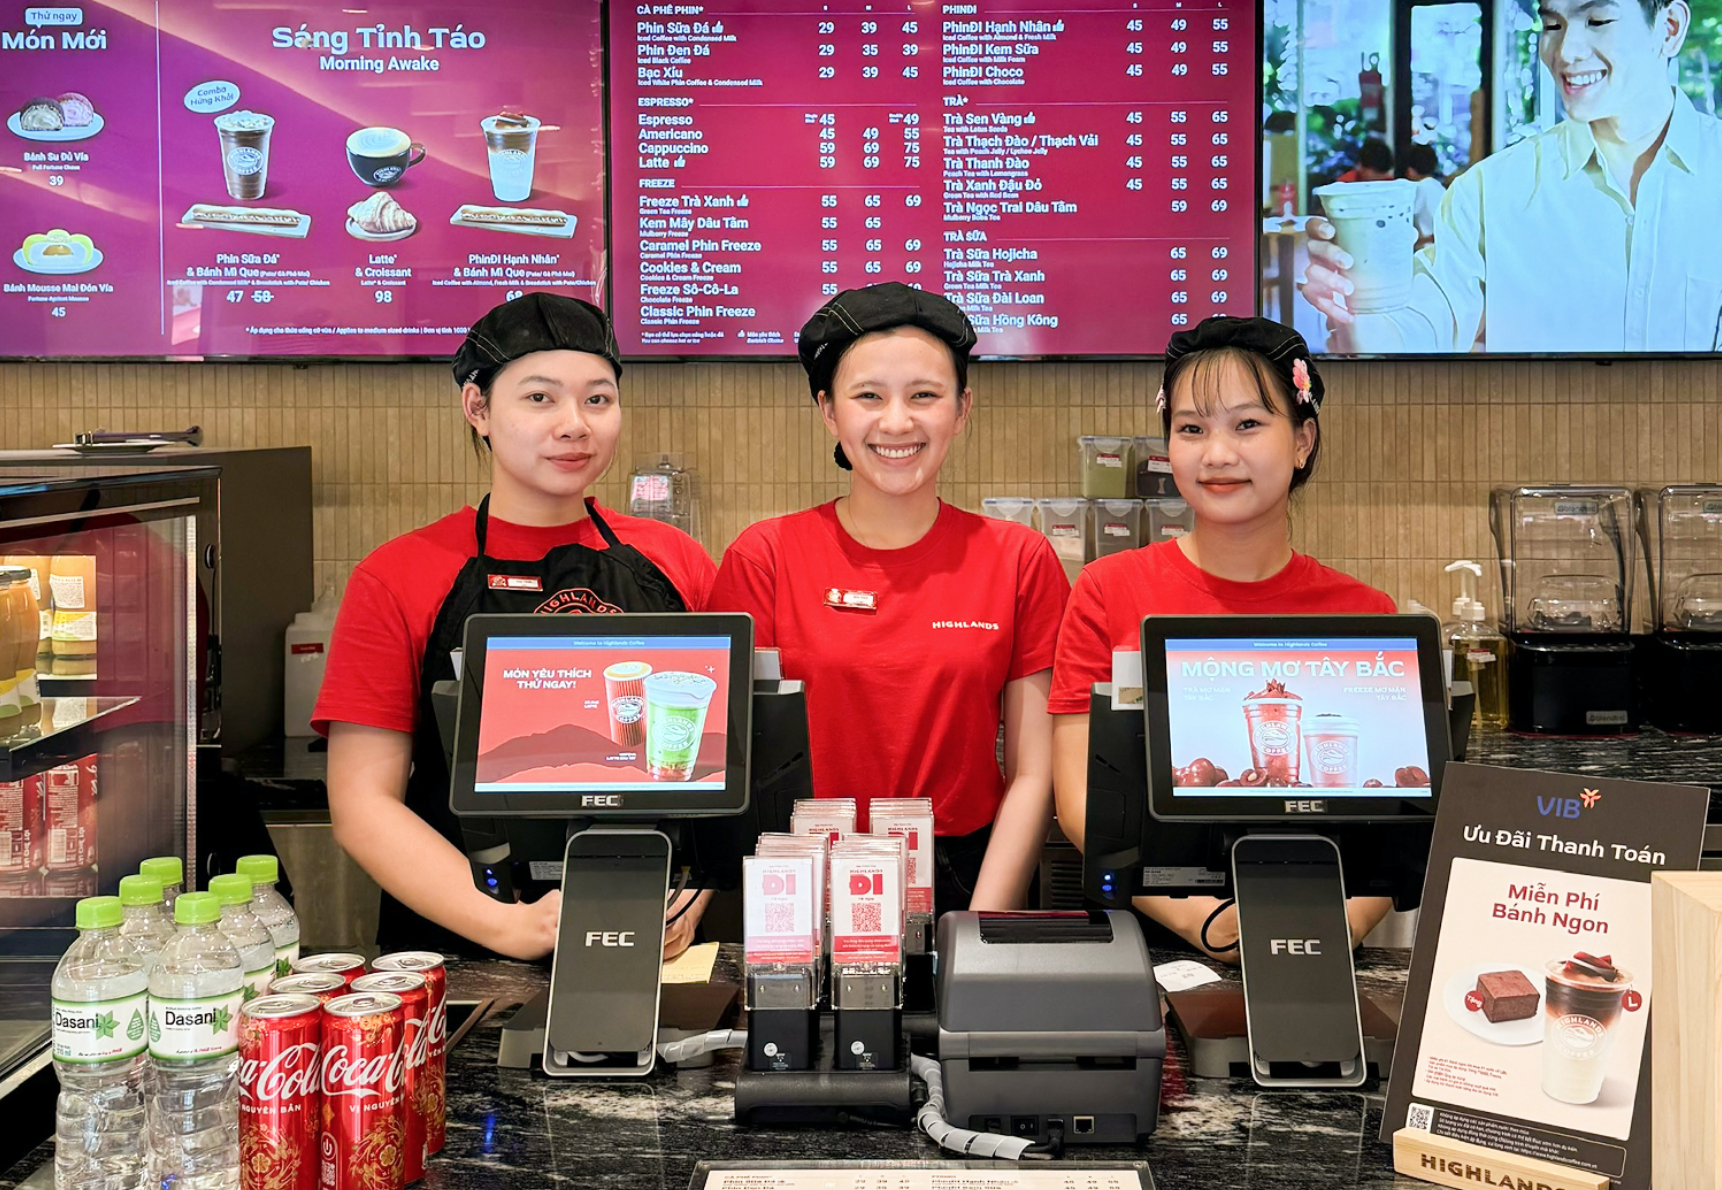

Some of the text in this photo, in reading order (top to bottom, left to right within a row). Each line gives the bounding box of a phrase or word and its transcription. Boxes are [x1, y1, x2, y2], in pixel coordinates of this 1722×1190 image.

[636, 4, 652, 15] CÀ
[652, 4, 673, 14] PHÊ
[30, 10, 78, 22] Thử ngay
[637, 22, 710, 34] Phin Sữa Đá
[818, 22, 834, 34] 29
[861, 22, 877, 34] 39
[902, 22, 918, 34] 45
[985, 20, 1017, 34] Hạnh
[1019, 20, 1051, 32] Nhân
[1126, 19, 1143, 31] 45
[1170, 19, 1187, 30] 49
[1213, 18, 1228, 30] 55
[2, 26, 106, 50] Món Mới
[272, 24, 486, 55] Sáng Tỉnh Táo
[320, 56, 440, 74] Morning Awake
[638, 66, 661, 80] Bạc
[985, 66, 1024, 78] Choco
[638, 114, 693, 126] Espresso
[943, 112, 1022, 126] Trà Sen Vàng
[638, 128, 703, 140] Americano
[943, 134, 1098, 148] Trà Thạch Đào / Thạch Vải
[24, 152, 46, 161] Bánh
[47, 152, 60, 162] Su
[73, 152, 89, 161] Vía
[49, 175, 64, 186] 39
[639, 178, 675, 188] FREEZE
[639, 194, 734, 207] Freeze Trà Xanh
[640, 217, 667, 228] Kem
[669, 216, 695, 230] Mây
[697, 216, 721, 228] Dâu
[943, 230, 988, 242] TRÀ SỮA
[216, 254, 240, 264] Phin
[241, 254, 262, 264] Sữa
[503, 254, 529, 266] Hạnh
[943, 248, 1038, 260] Trà Sữa Hojicha
[186, 267, 195, 277] &
[196, 266, 222, 277] Bánh
[239, 267, 260, 278] Que
[355, 267, 412, 277] & Croissant
[453, 267, 461, 277] &
[463, 267, 488, 277] Bánh
[505, 267, 526, 278] Que
[3, 283, 26, 292] Bánh
[27, 284, 61, 292] Mousse
[62, 283, 79, 292] Mai
[98, 283, 114, 292] Vía
[226, 290, 244, 303] 47
[375, 290, 392, 303] 98
[52, 307, 66, 317] 45
[967, 313, 1058, 328] Sữa Hồng Kông
[932, 620, 999, 630] HIGHLANDS
[1182, 651, 1404, 682] MỘNG MƠ TÂY BẮC
[503, 667, 592, 680] MÓN YÊU THÍCH
[516, 678, 576, 689] THỬ NGAY!
[1344, 686, 1374, 694] FREEZE
[1260, 744, 1291, 755] COFFEE
[582, 795, 618, 806] FEC
[1285, 800, 1323, 812] FEC
[1536, 794, 1581, 820] VIB
[1462, 824, 1667, 867] Ưu Đãi Thanh Toán
[1508, 882, 1601, 911] Miễn Phí
[1492, 902, 1610, 936] Bánh Ngon
[585, 932, 635, 946] FEC
[1270, 939, 1322, 955] FEC
[1466, 994, 1482, 1008] Tặng
[1626, 996, 1638, 1008] L
[56, 1012, 99, 1030] Dasani
[165, 1008, 216, 1026] Dasani
[1554, 1014, 1606, 1039] HIGHLANDS
[349, 1096, 400, 1114] VỊ NGUYÊN
